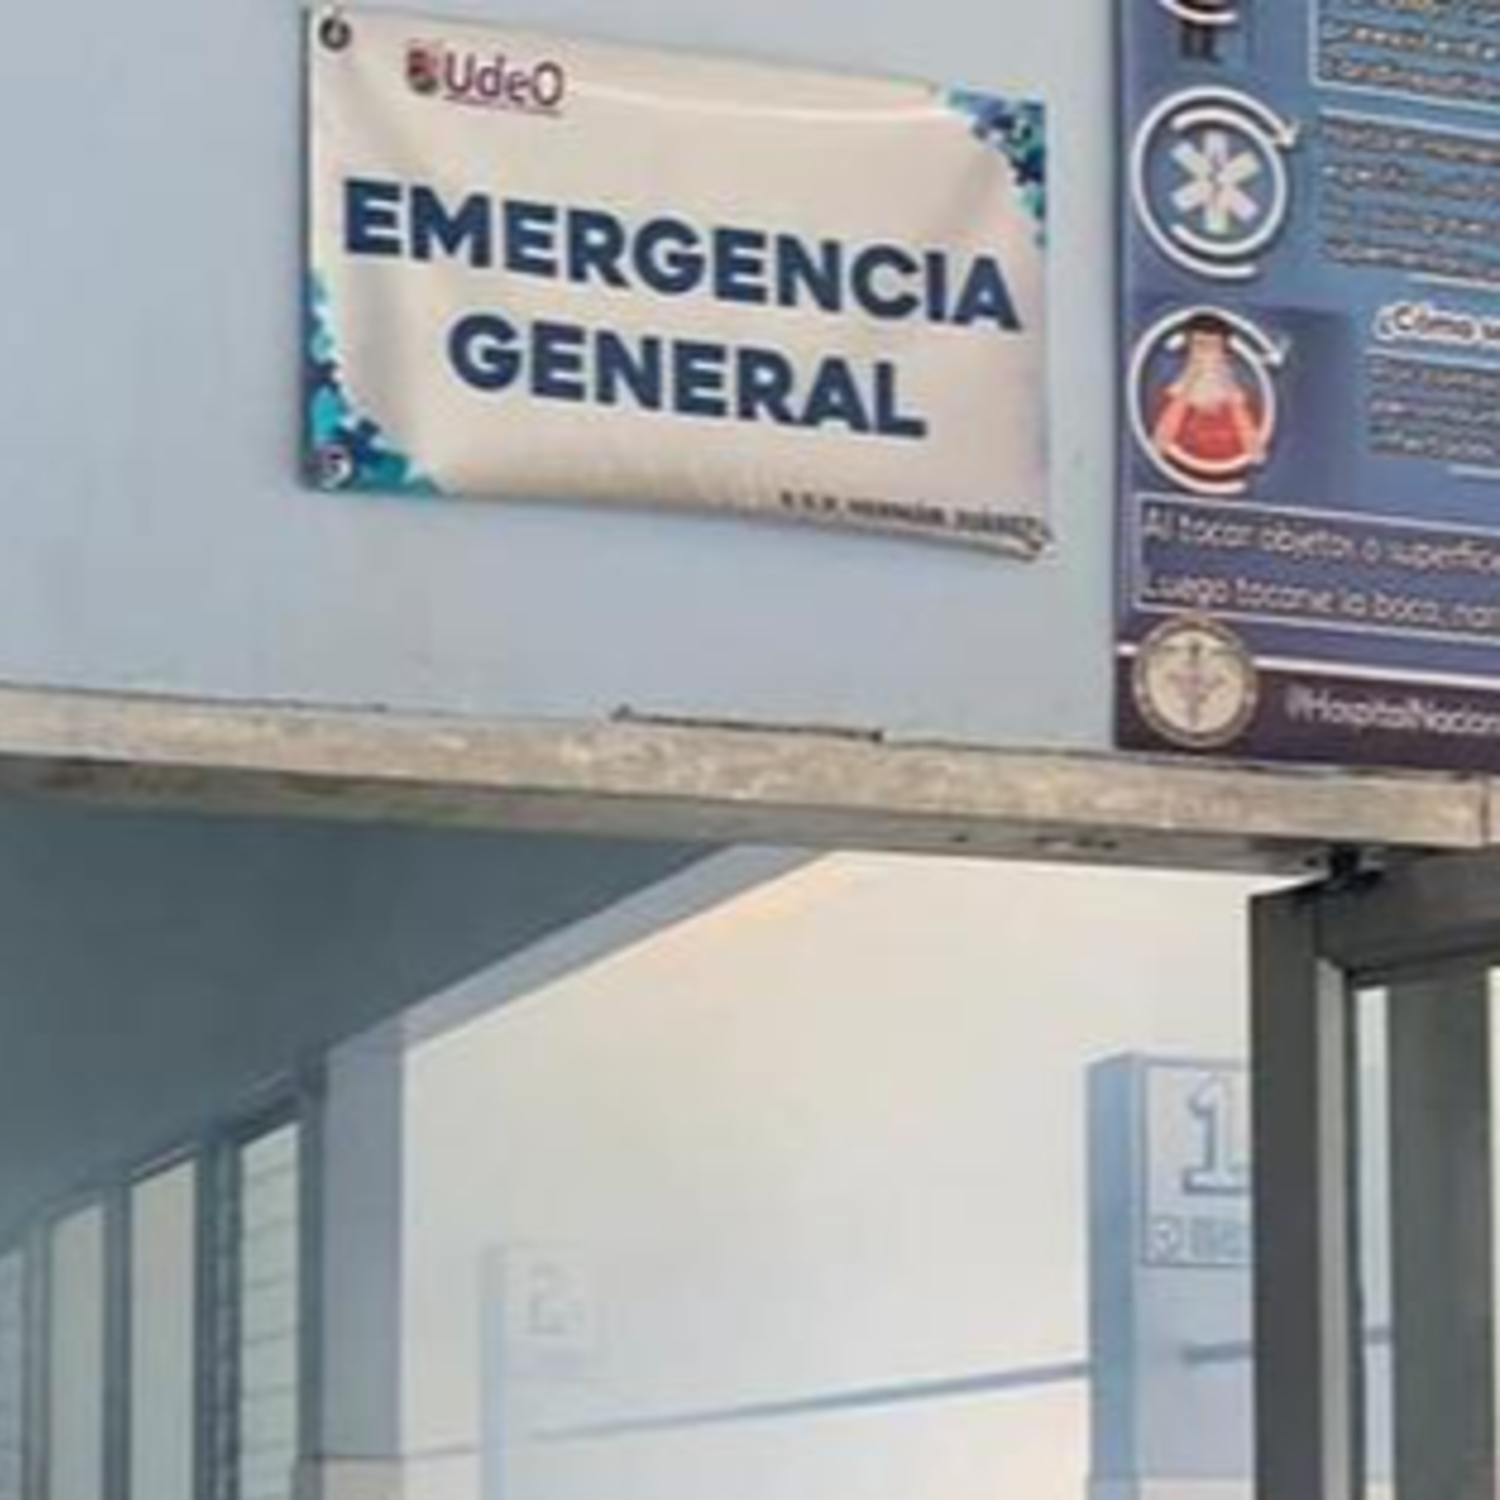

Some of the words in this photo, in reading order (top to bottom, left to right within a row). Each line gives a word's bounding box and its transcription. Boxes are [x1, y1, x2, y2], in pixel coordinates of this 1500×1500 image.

[445, 52, 564, 108] UdeO
[342, 175, 1024, 333] EMERGENCIA
[446, 312, 928, 441] GENERAL
[1179, 515, 1251, 547] tocar
[1182, 1072, 1250, 1195] 1
